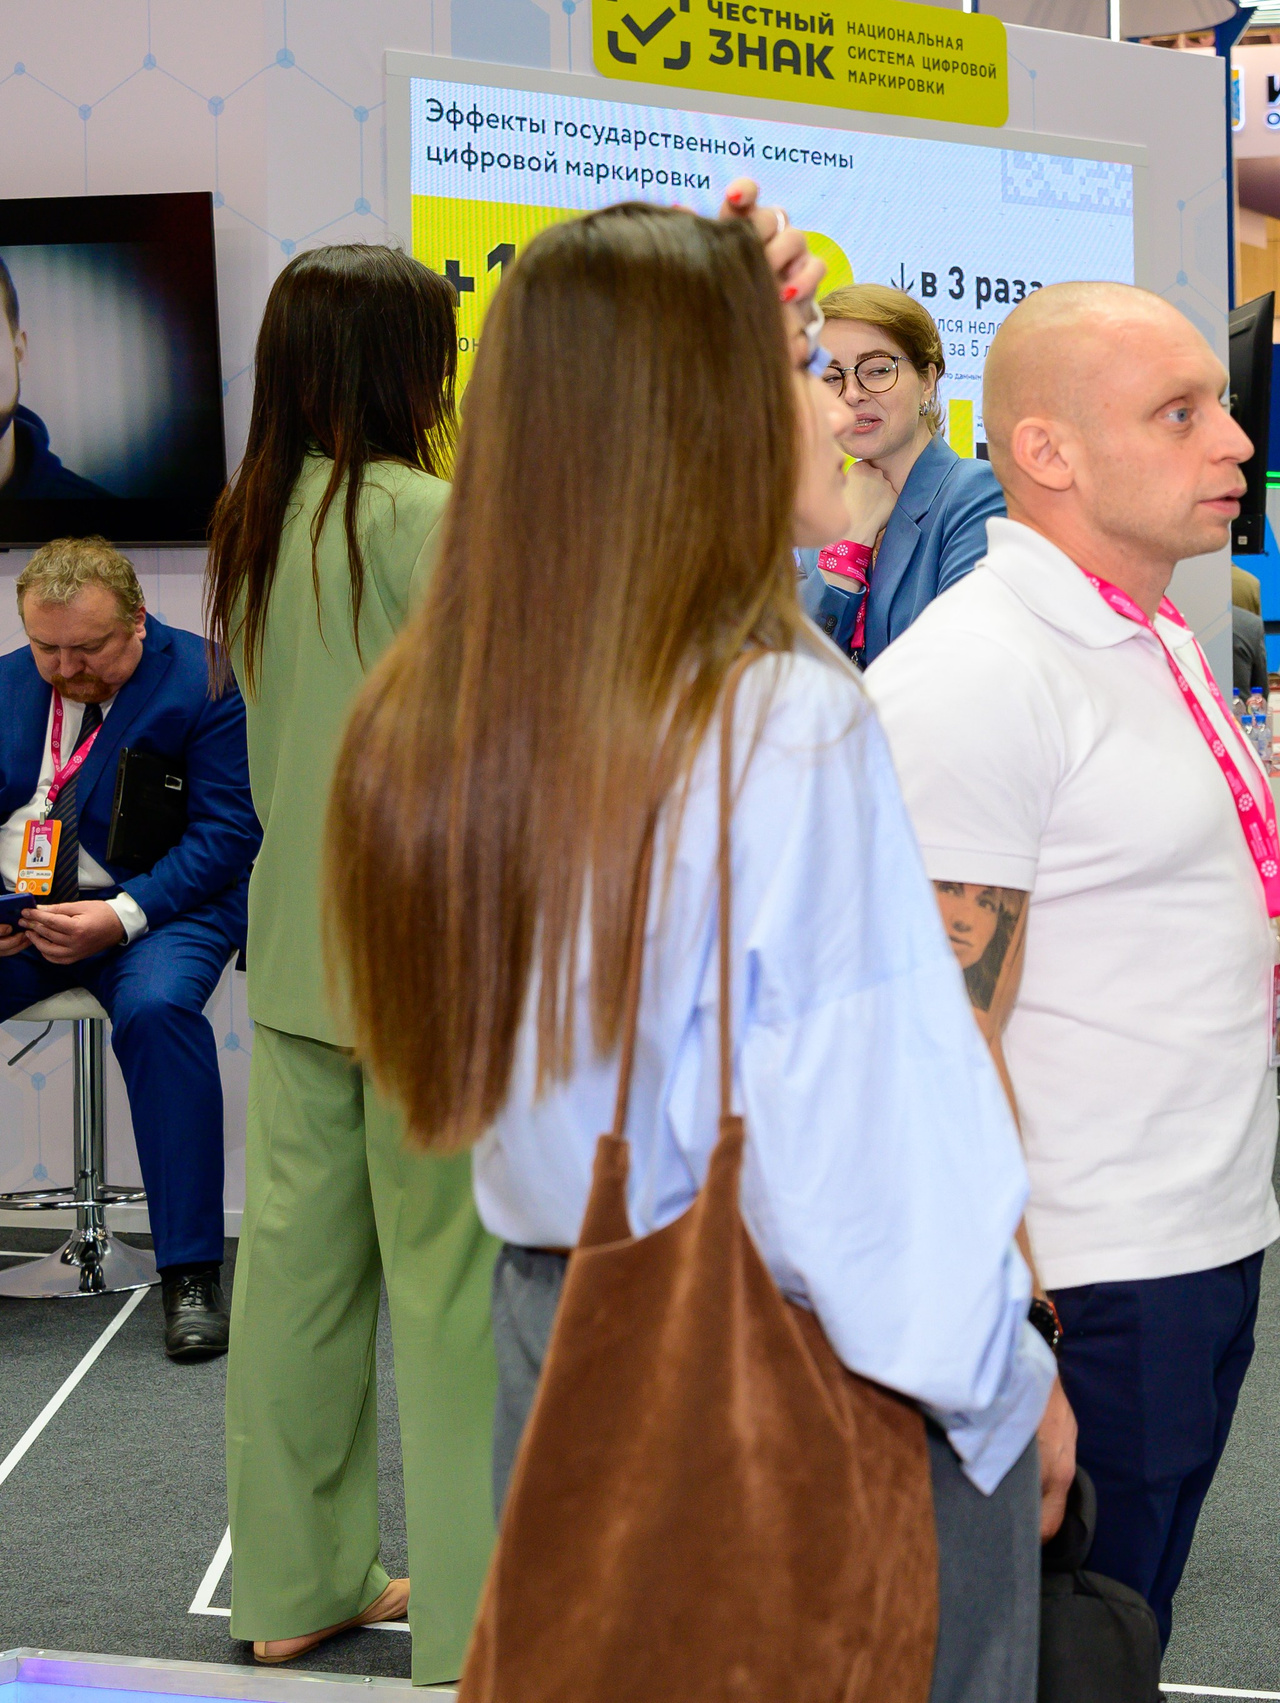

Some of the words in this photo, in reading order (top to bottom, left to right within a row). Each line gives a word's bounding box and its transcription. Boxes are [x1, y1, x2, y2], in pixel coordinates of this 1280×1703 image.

[708, 0, 835, 36] ЧЕСТНЫЙ
[847, 21, 964, 51] НАЦИОНАЛЬНАЯ
[708, 28, 836, 80] ЗНАК
[847, 45, 916, 68] СИСТЕМА
[922, 54, 998, 80] ЦИФРОВОЙ
[848, 70, 945, 95] МАРКИРОВКИ
[426, 98, 547, 134] Эффекты
[554, 120, 756, 160] государственной
[762, 141, 855, 170] системы
[427, 142, 558, 173] цифровой
[565, 160, 711, 190] маркировки
[921, 271, 938, 298] в
[948, 266, 965, 300] 3
[970, 340, 979, 357] 5
